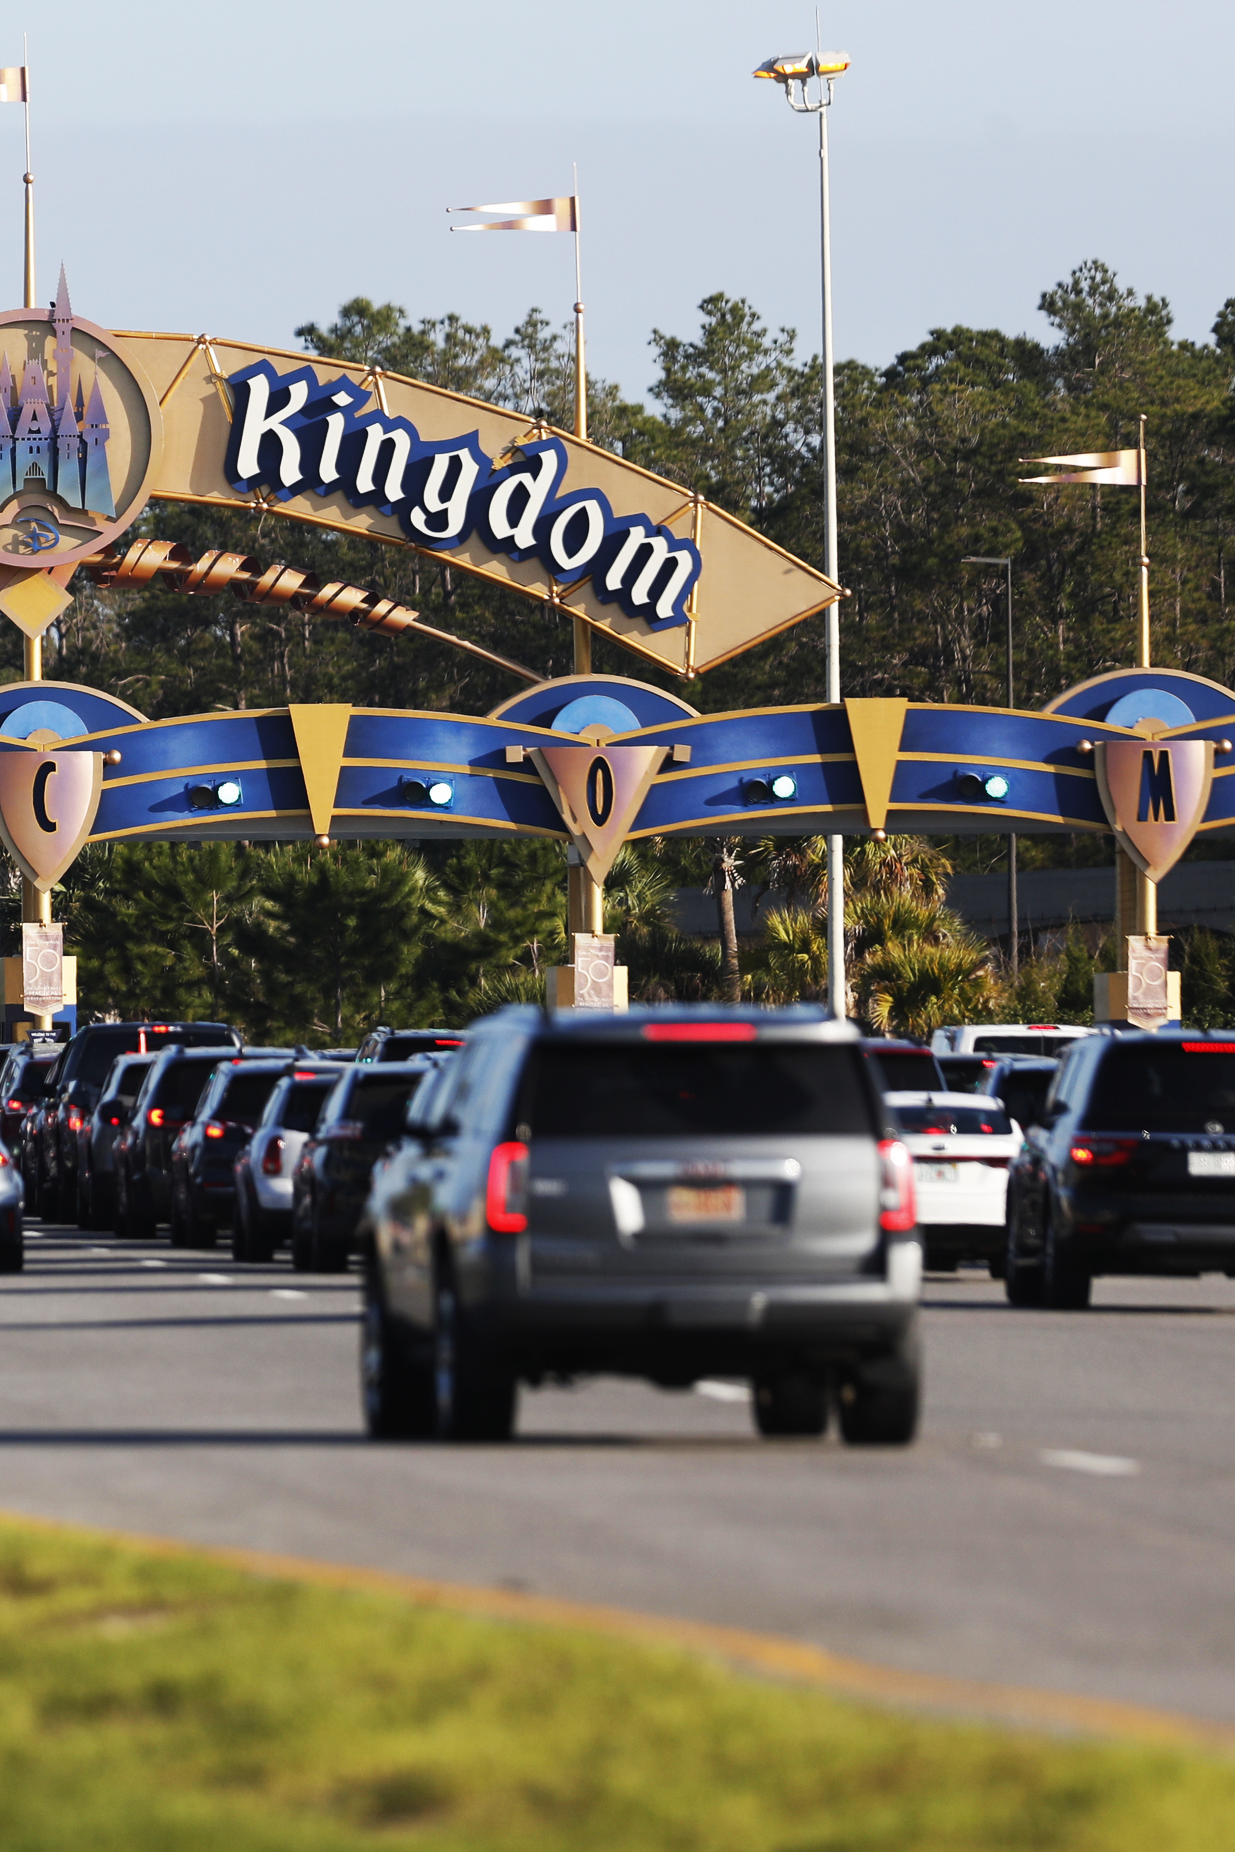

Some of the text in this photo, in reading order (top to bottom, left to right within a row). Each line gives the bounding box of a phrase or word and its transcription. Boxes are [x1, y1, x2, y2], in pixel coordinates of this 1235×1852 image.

[236, 373, 693, 619] Kingdom
[32, 760, 57, 833] C
[587, 756, 613, 827] O
[1137, 749, 1176, 822] M
[26, 946, 60, 983] 50
[578, 957, 611, 993] 50
[1131, 960, 1165, 995] 50
